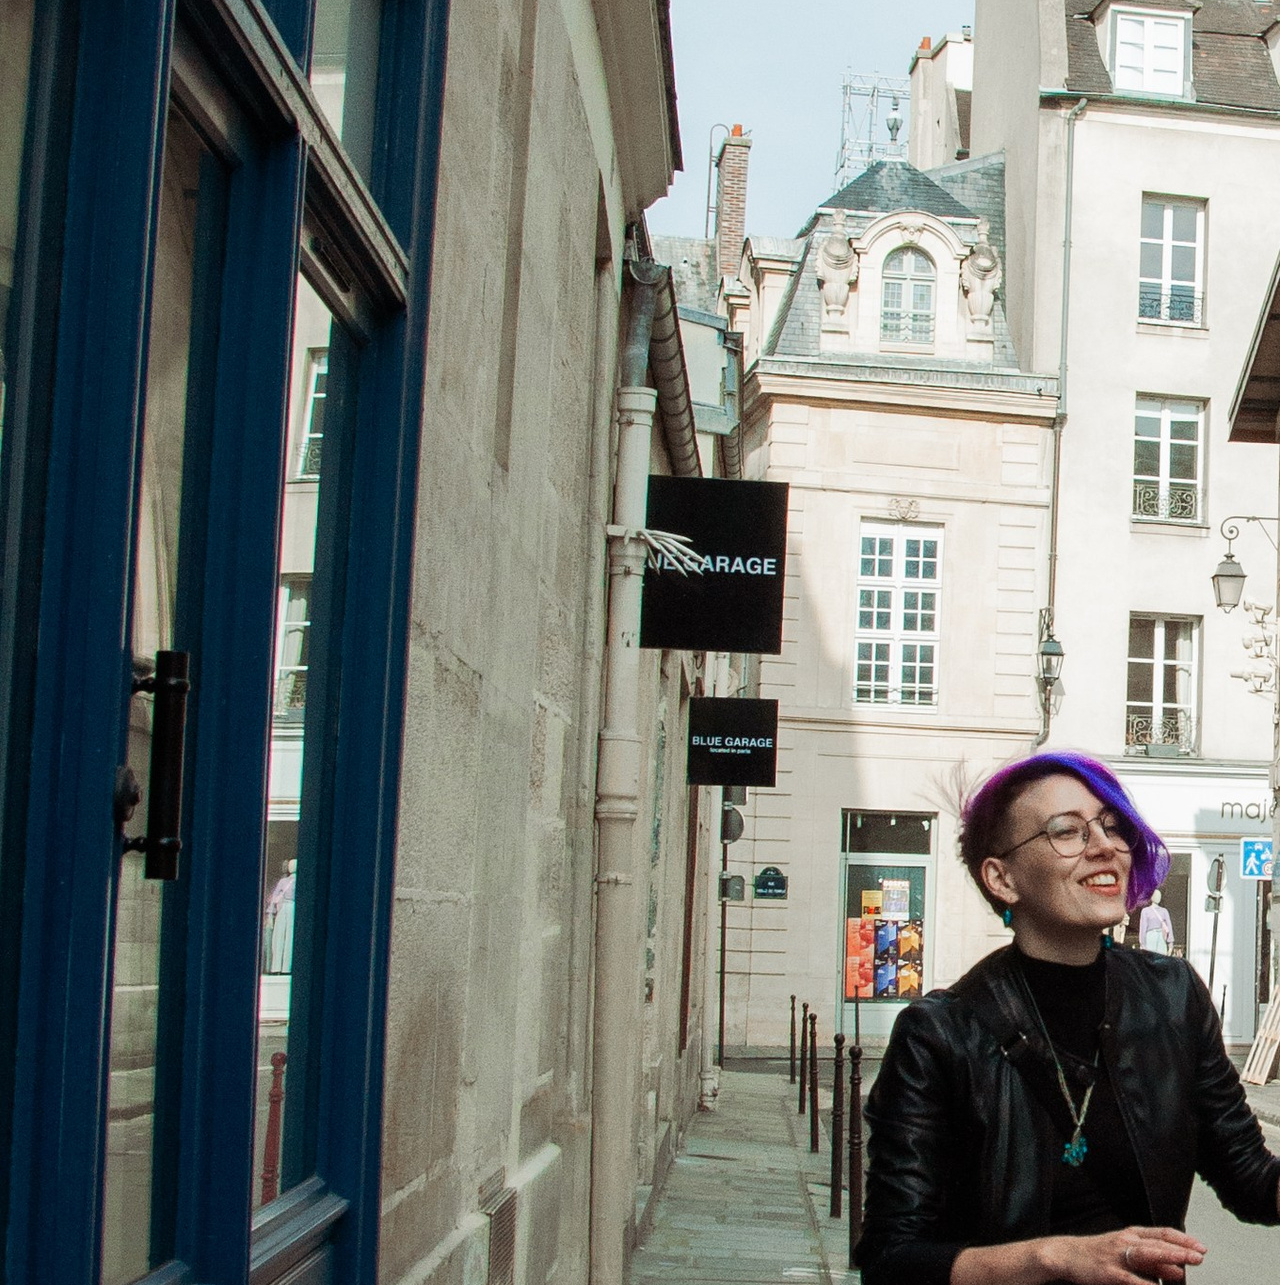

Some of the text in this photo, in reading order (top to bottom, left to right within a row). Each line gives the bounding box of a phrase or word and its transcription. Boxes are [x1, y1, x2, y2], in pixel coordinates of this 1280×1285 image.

[643, 553, 777, 576] UE GARAGE
[692, 736, 773, 748] BLUE GARAGE
